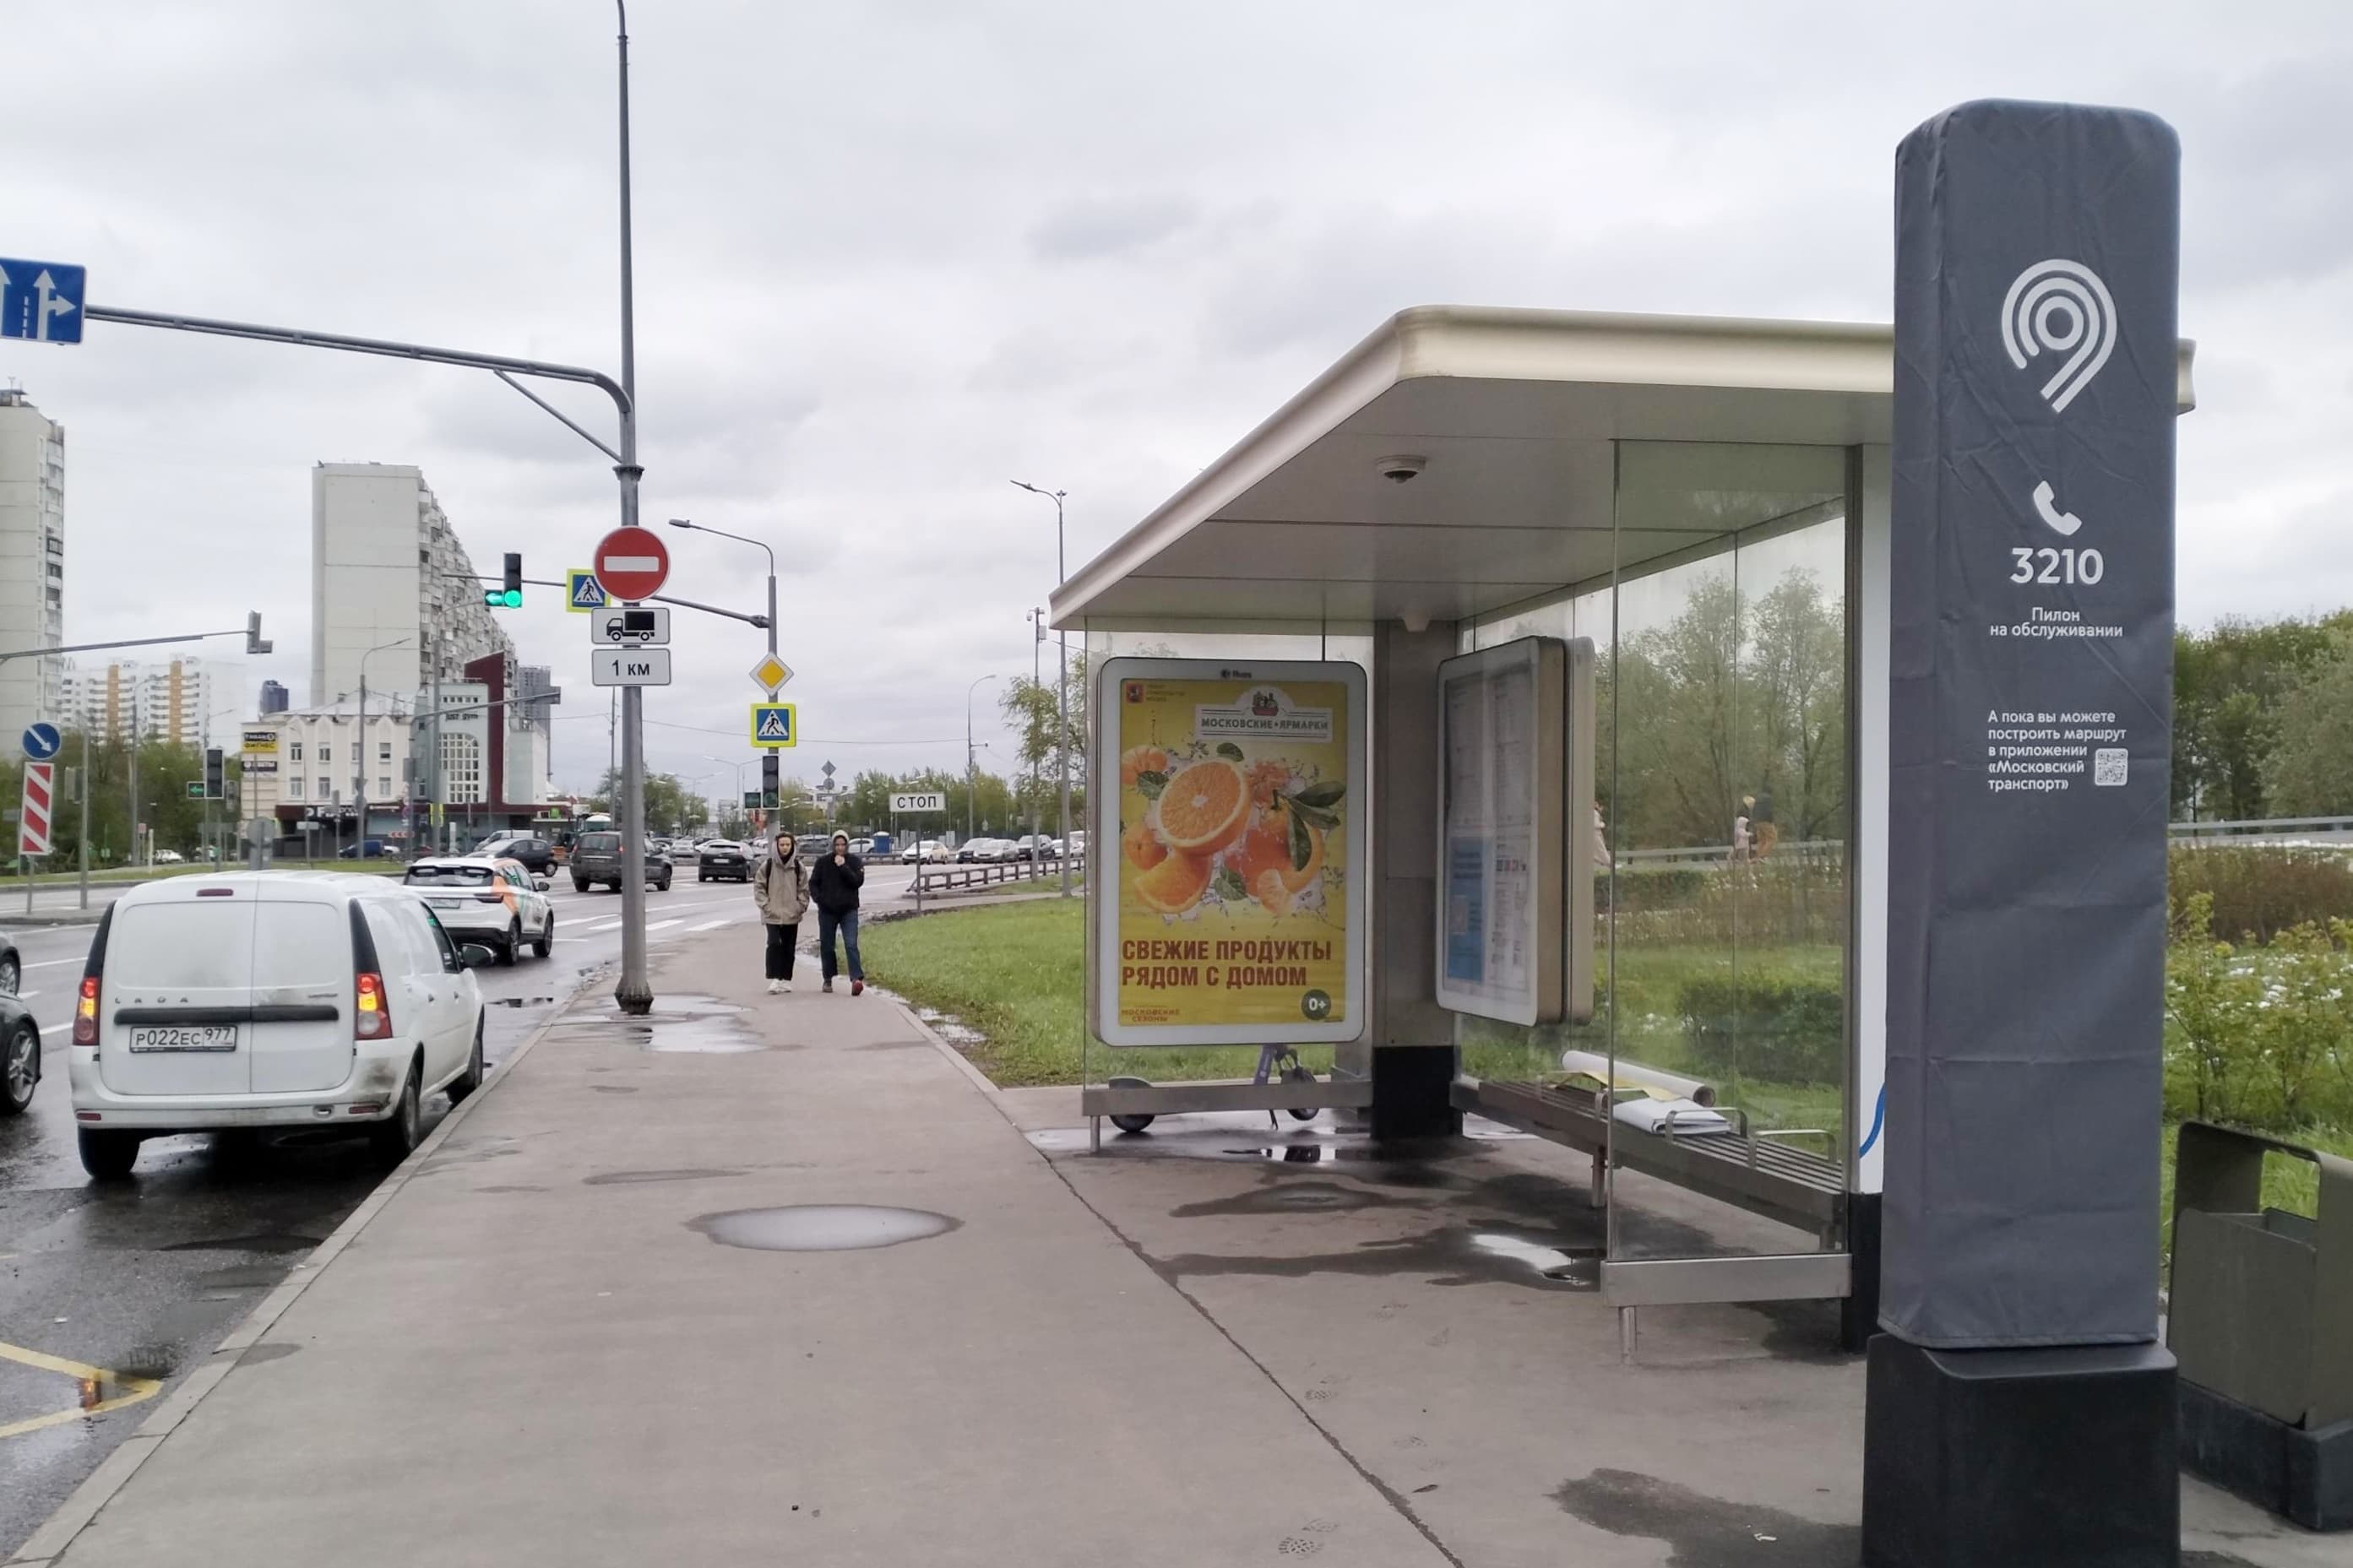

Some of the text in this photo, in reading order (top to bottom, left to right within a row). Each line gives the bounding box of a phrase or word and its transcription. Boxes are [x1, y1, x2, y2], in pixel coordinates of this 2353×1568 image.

[2010, 547, 2104, 584] 3210
[2032, 607, 2080, 621] Пилон
[1990, 622, 2122, 639] на обслуживании
[611, 659, 619, 675] 1
[1988, 710, 2115, 723] А пока вы можете
[1201, 718, 1329, 730] МОСКОВСКИЕ ЯРМАРКИ
[1988, 729, 2127, 742] построить маршрут
[1988, 746, 2087, 759] в приложении
[1988, 759, 2084, 773] «Московский
[1988, 779, 2068, 793] транспорт»
[897, 796, 937, 809] СТОП
[1122, 940, 1331, 963] СВЕЖИЕ ПРОДУКТЫ
[1122, 966, 1307, 989] РЯДОМ С ДОМОМ
[1308, 997, 1327, 1012] 0+
[204, 1028, 231, 1040] 977
